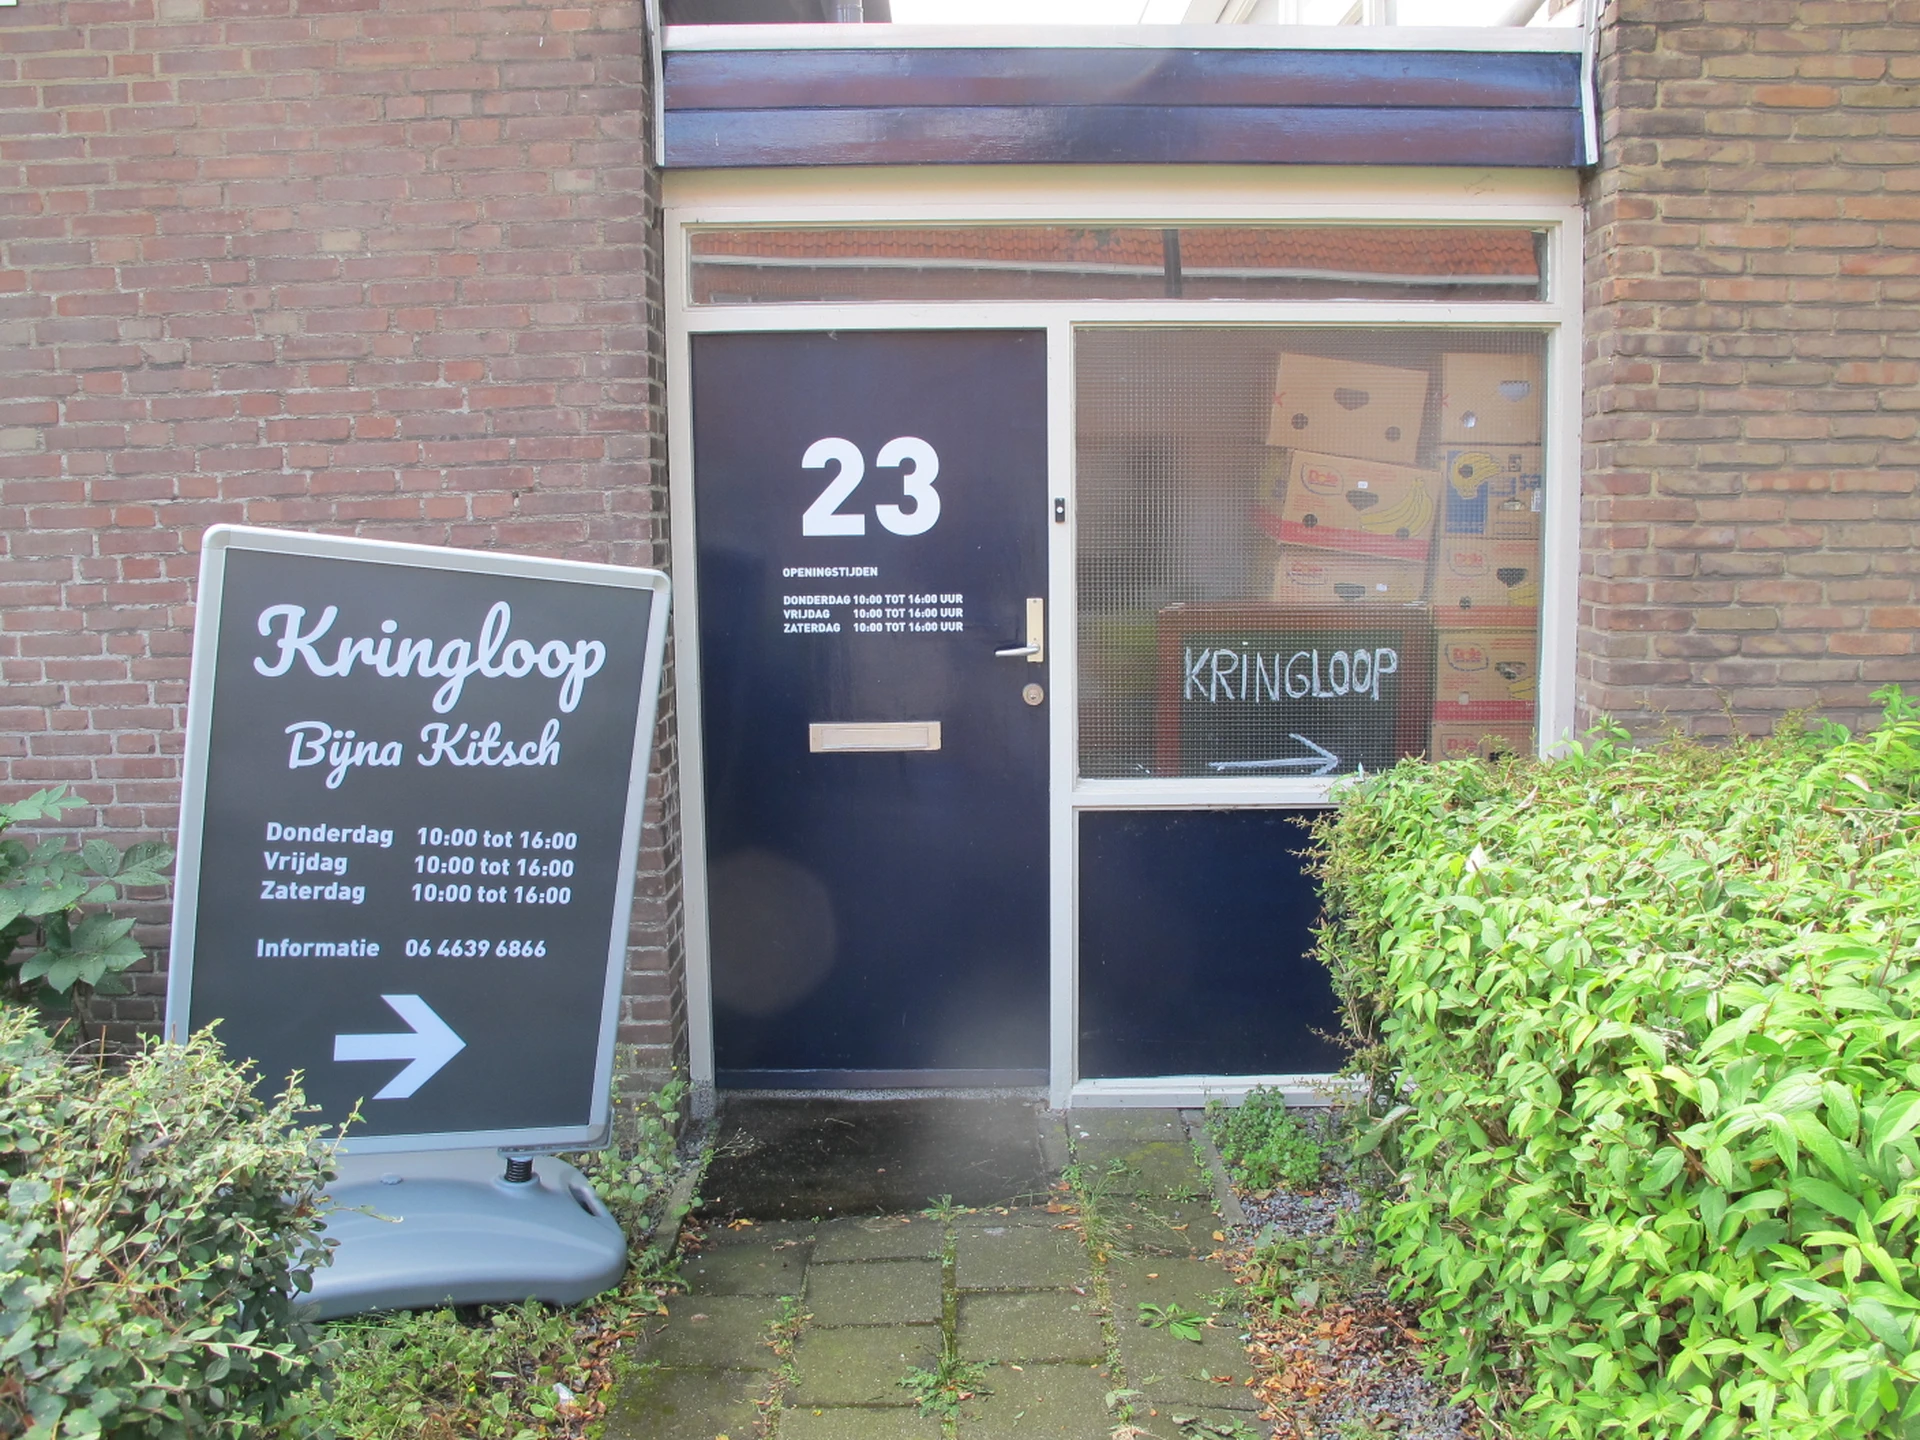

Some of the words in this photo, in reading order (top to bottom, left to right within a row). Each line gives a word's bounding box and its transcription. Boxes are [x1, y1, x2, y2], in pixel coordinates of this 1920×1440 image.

[802, 436, 940, 536] 23
[783, 567, 877, 577] OPENINGSTIJDEN
[784, 595, 851, 605] DONDERDAG
[853, 595, 882, 604] 10:00
[885, 594, 905, 604] TOT
[908, 594, 937, 603] 16:00
[940, 594, 963, 603] UUR
[784, 609, 830, 619] VRIJDAG
[854, 609, 882, 618] 10:00
[885, 608, 905, 618] TOT
[909, 608, 937, 617] 16:00
[941, 608, 963, 617] UUR
[784, 623, 840, 633] ZATERDAG
[854, 623, 882, 632] 10:00
[885, 623, 905, 631] TOT
[909, 622, 937, 631] 16:00
[941, 622, 963, 631] UUR
[254, 601, 605, 713] Kringloop
[285, 721, 402, 789] Bijna
[418, 719, 560, 766] Kitsch
[267, 822, 393, 847] Donderdag
[418, 828, 477, 846] 10:00
[484, 831, 513, 847] tot
[521, 831, 577, 849] 16:00
[264, 852, 347, 875] Vrijdag
[415, 856, 474, 874] 10:00
[480, 859, 510, 875] tot
[517, 859, 573, 877] 16:00
[261, 881, 365, 904] Zaterdag
[412, 884, 471, 902] 10:00
[477, 886, 507, 903] tot
[514, 886, 570, 904] 16:00
[258, 939, 379, 957] Informatie
[406, 939, 431, 956] 06
[437, 940, 490, 957] 4639
[496, 940, 545, 957] 6866
